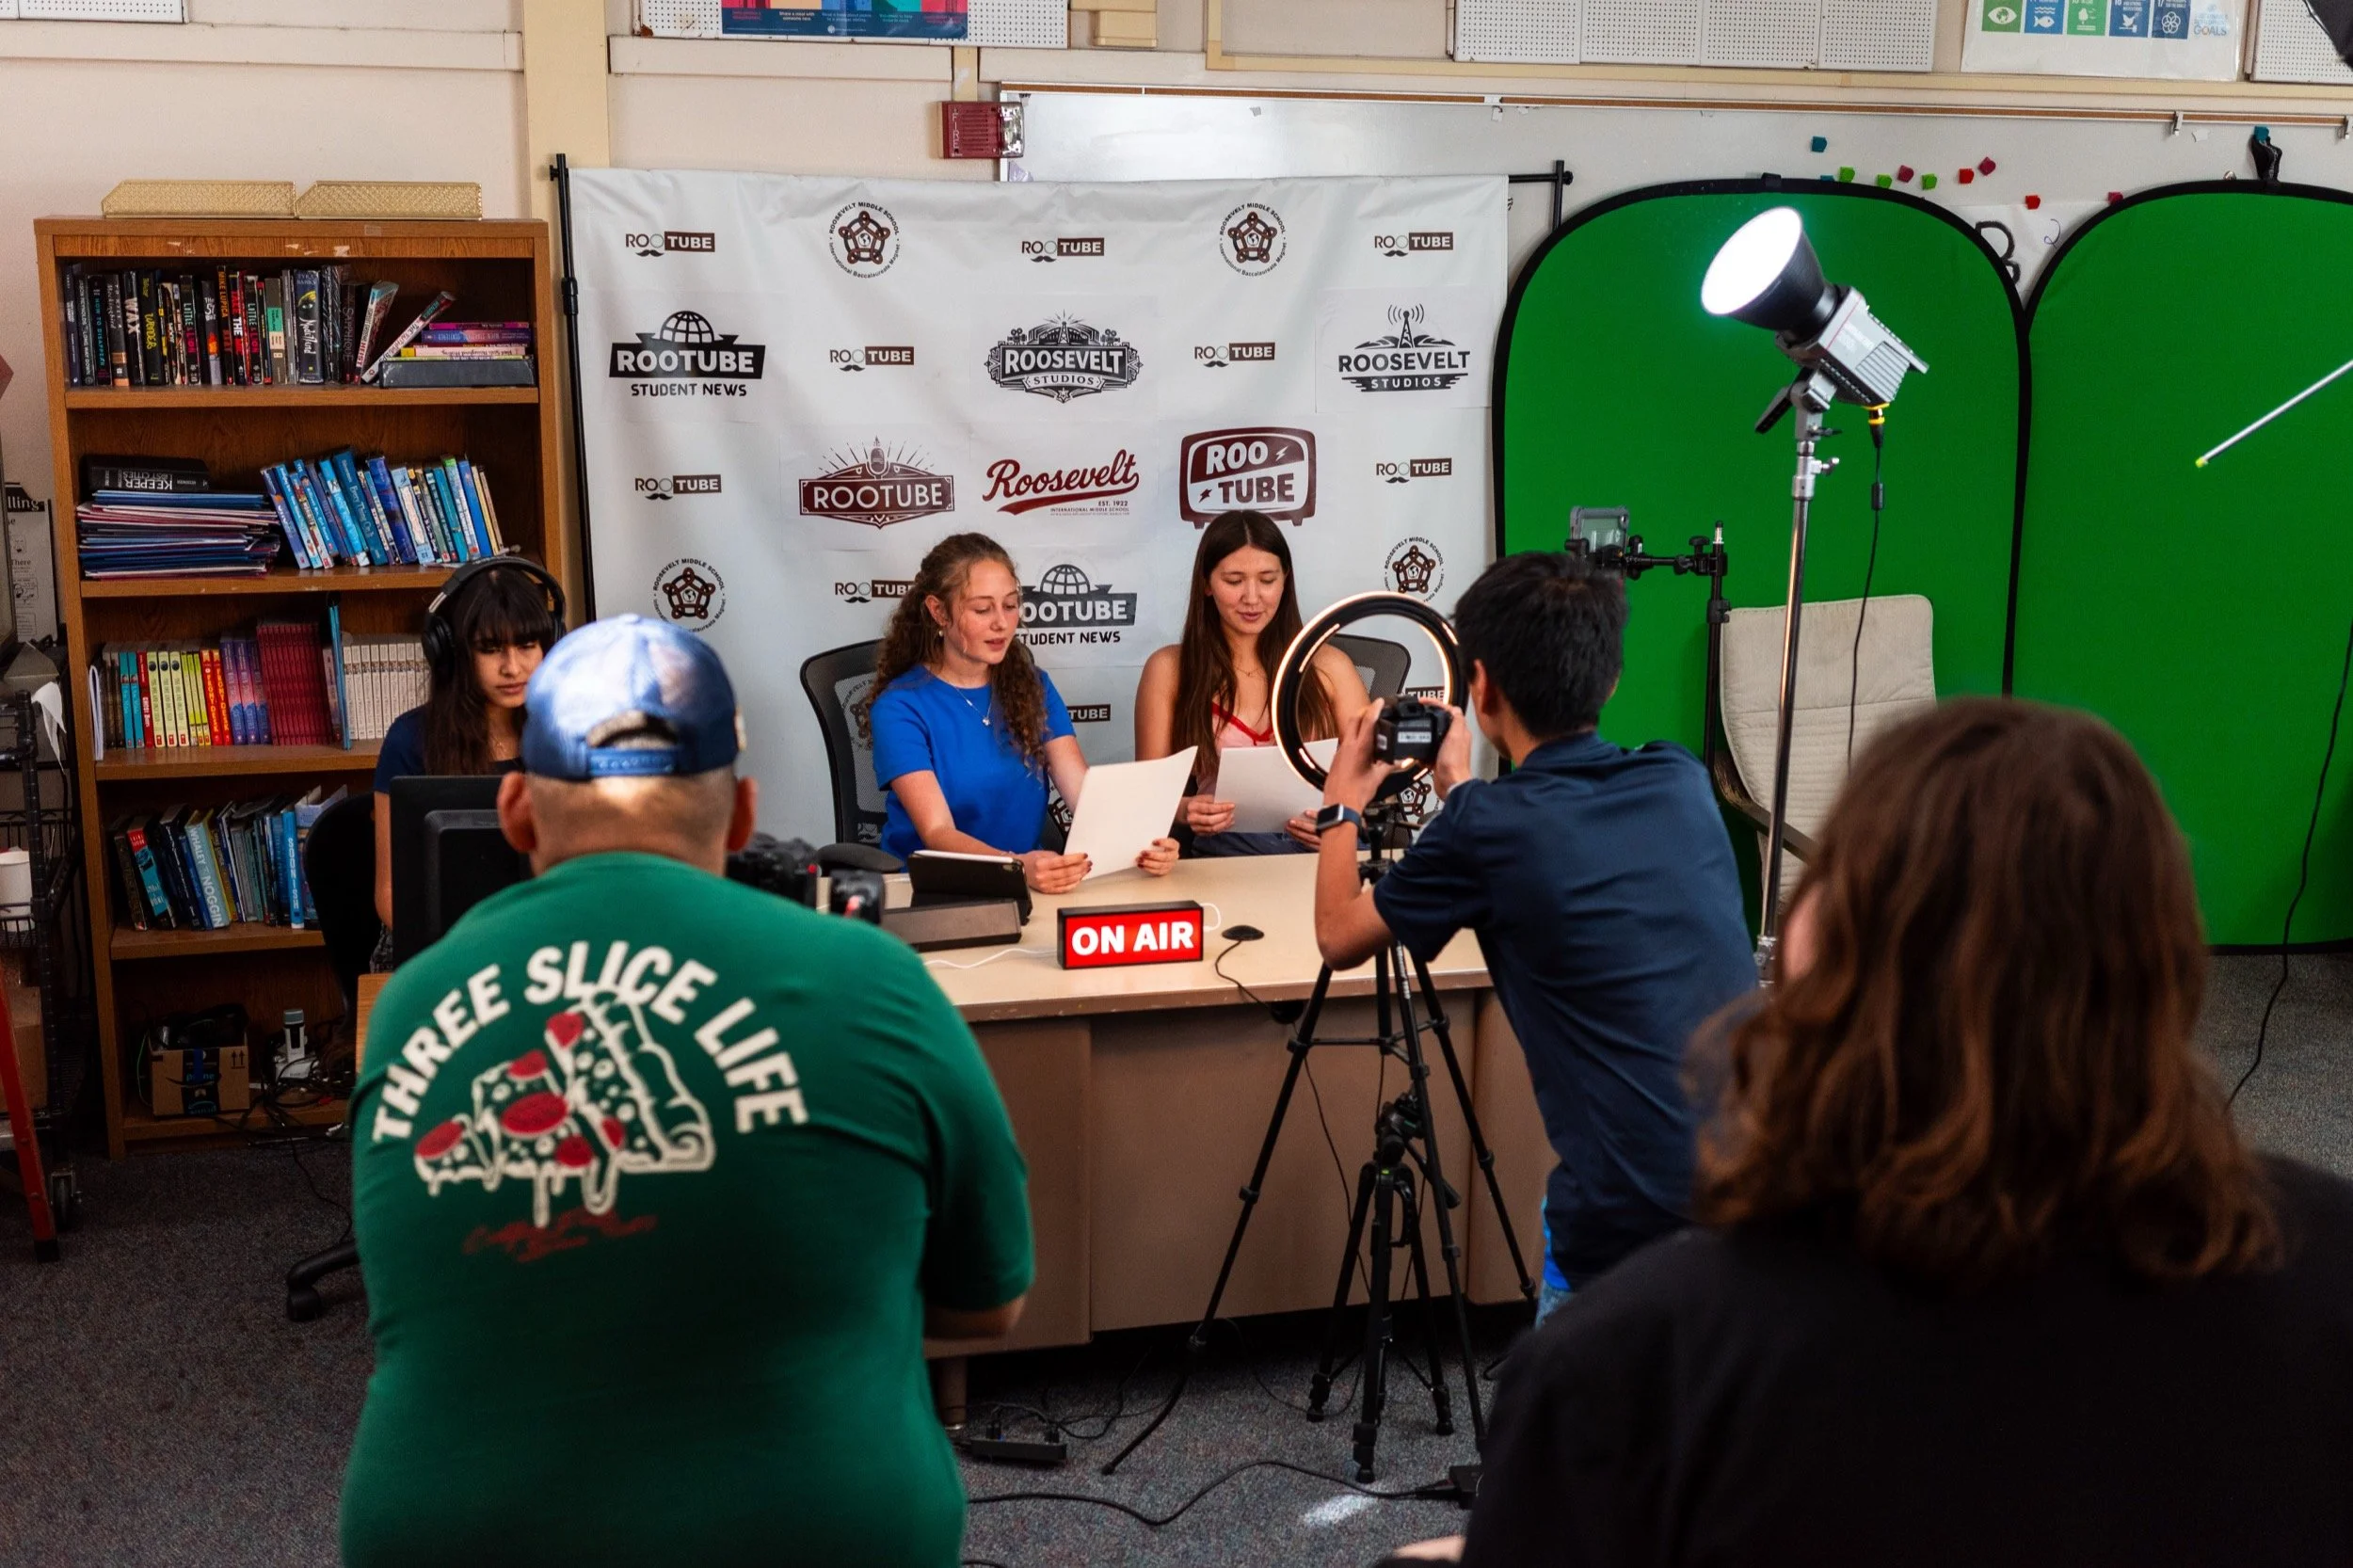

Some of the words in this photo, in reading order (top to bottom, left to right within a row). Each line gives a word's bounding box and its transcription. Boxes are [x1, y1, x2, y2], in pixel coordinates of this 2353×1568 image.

[2194, 25, 2227, 36] GOALS
[952, 113, 960, 150] FIRE
[829, 202, 856, 234] ROOSEVELT
[857, 201, 884, 212] MIDDLE
[883, 210, 900, 235] SCHOOL
[1219, 204, 1245, 235] ROOSEVELT
[1247, 202, 1271, 212] MIDDLE
[1271, 210, 1287, 234] SCHOOL
[829, 243, 853, 274] International
[853, 264, 890, 279] Baccalaureate
[888, 244, 900, 265] Magnet
[124, 297, 140, 335] WAX
[220, 292, 229, 318] LUPICA
[232, 316, 244, 337] THE
[343, 307, 355, 361] SAPPHIQUE
[356, 342, 366, 368] HEIST
[616, 349, 755, 374] ROOTUBE
[1004, 347, 1126, 375] ROOSEVELT
[1337, 351, 1470, 373] ROOSEVELT
[631, 383, 697, 397] STUDENT
[702, 383, 747, 397] NEWS
[1033, 375, 1096, 386] STUDIOS
[1370, 376, 1442, 389] STUDIOS
[1206, 440, 1269, 475] ROO
[124, 478, 173, 489] KEEPER
[983, 449, 1140, 503] Roosevelt
[1218, 472, 1295, 504] TUBE
[8, 495, 40, 512] lling
[349, 485, 360, 503] Every
[813, 483, 943, 509] ROOTUBE
[1385, 538, 1408, 569] ROOSEVELT
[1430, 542, 1445, 567] SCHOOL
[653, 560, 680, 591] ROOSEVELT
[681, 558, 707, 568] MIDDLE
[707, 566, 725, 590] SCHOOL
[1020, 600, 1128, 622] OOTUBE
[1080, 631, 1121, 644] NEWS
[216, 668, 225, 701] FRONT
[220, 702, 230, 731] DESK
[190, 827, 205, 865] WHALEY
[201, 875, 223, 927] NOGGIN
[1071, 926, 1125, 955] ON
[1133, 921, 1195, 952] AIR
[373, 963, 511, 1143] THREE
[523, 940, 718, 1025] SLICE
[694, 998, 810, 1133] LIFE
